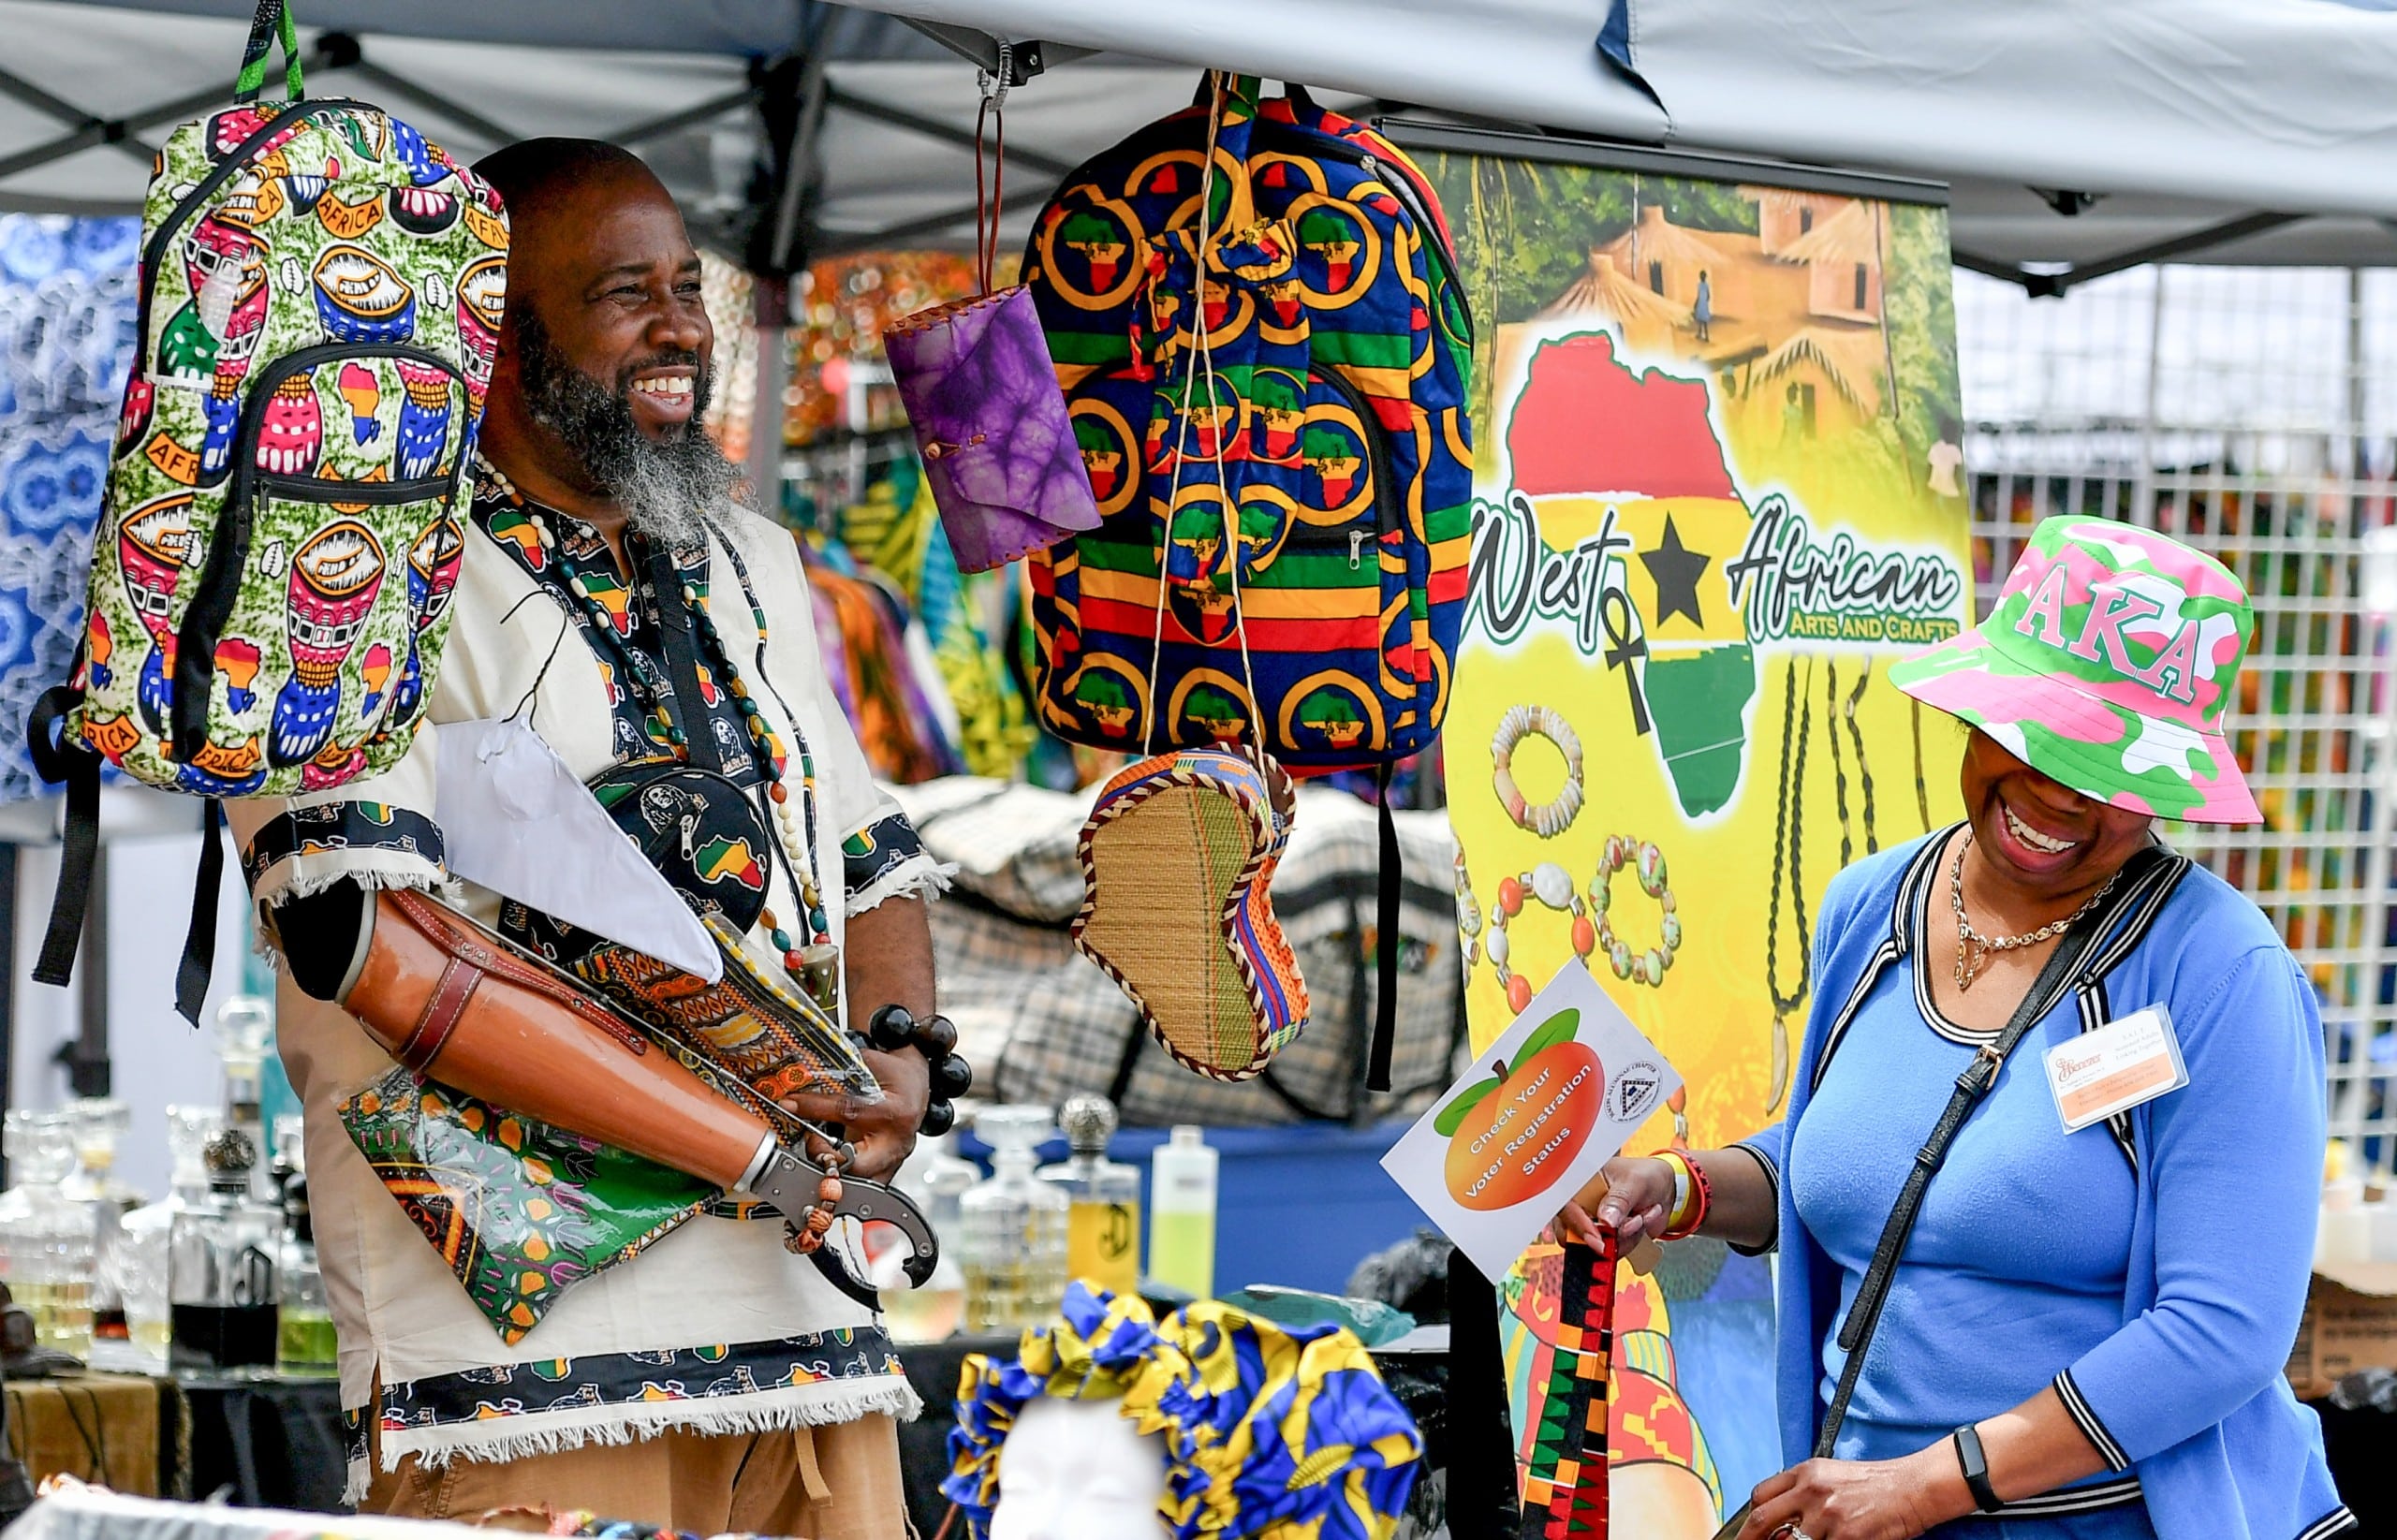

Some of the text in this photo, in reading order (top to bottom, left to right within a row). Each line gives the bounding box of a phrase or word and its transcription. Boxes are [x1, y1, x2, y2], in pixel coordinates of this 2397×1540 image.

[319, 198, 379, 234] AFRICA
[1464, 497, 1953, 643] West African
[1789, 611, 1960, 642] ARTS AND CRAFTS
[2013, 562, 2200, 706] AKA
[1465, 1064, 1592, 1198] Voter Registration
[1470, 1067, 1551, 1154] Check Your
[1522, 1127, 1571, 1176] Status
